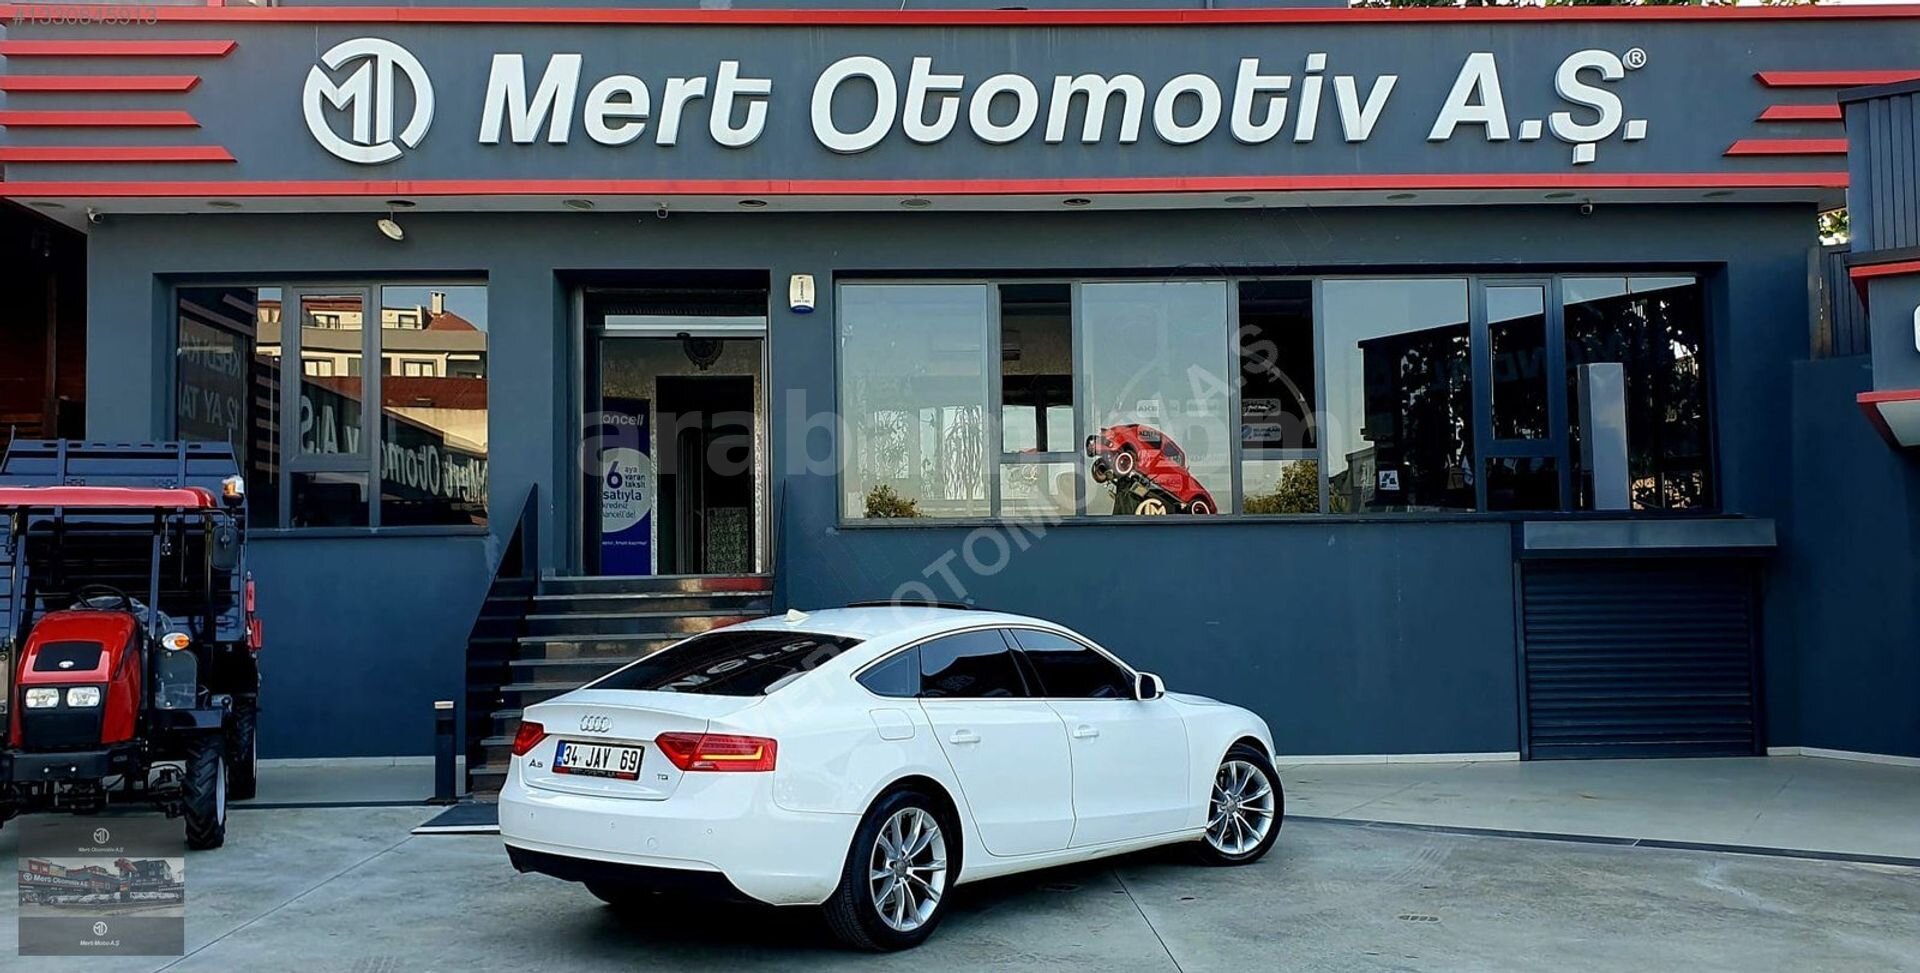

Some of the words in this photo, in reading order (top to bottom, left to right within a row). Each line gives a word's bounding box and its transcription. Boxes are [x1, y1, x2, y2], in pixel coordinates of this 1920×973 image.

[478, 53, 772, 147] Mert
[810, 53, 1397, 153] Otomotiv
[1427, 49, 1648, 165] A.Ş.
[600, 414, 644, 426] ancell
[602, 461, 623, 489] 6
[563, 745, 578, 766] 34
[585, 747, 611, 768] JAV
[620, 750, 639, 771] 69
